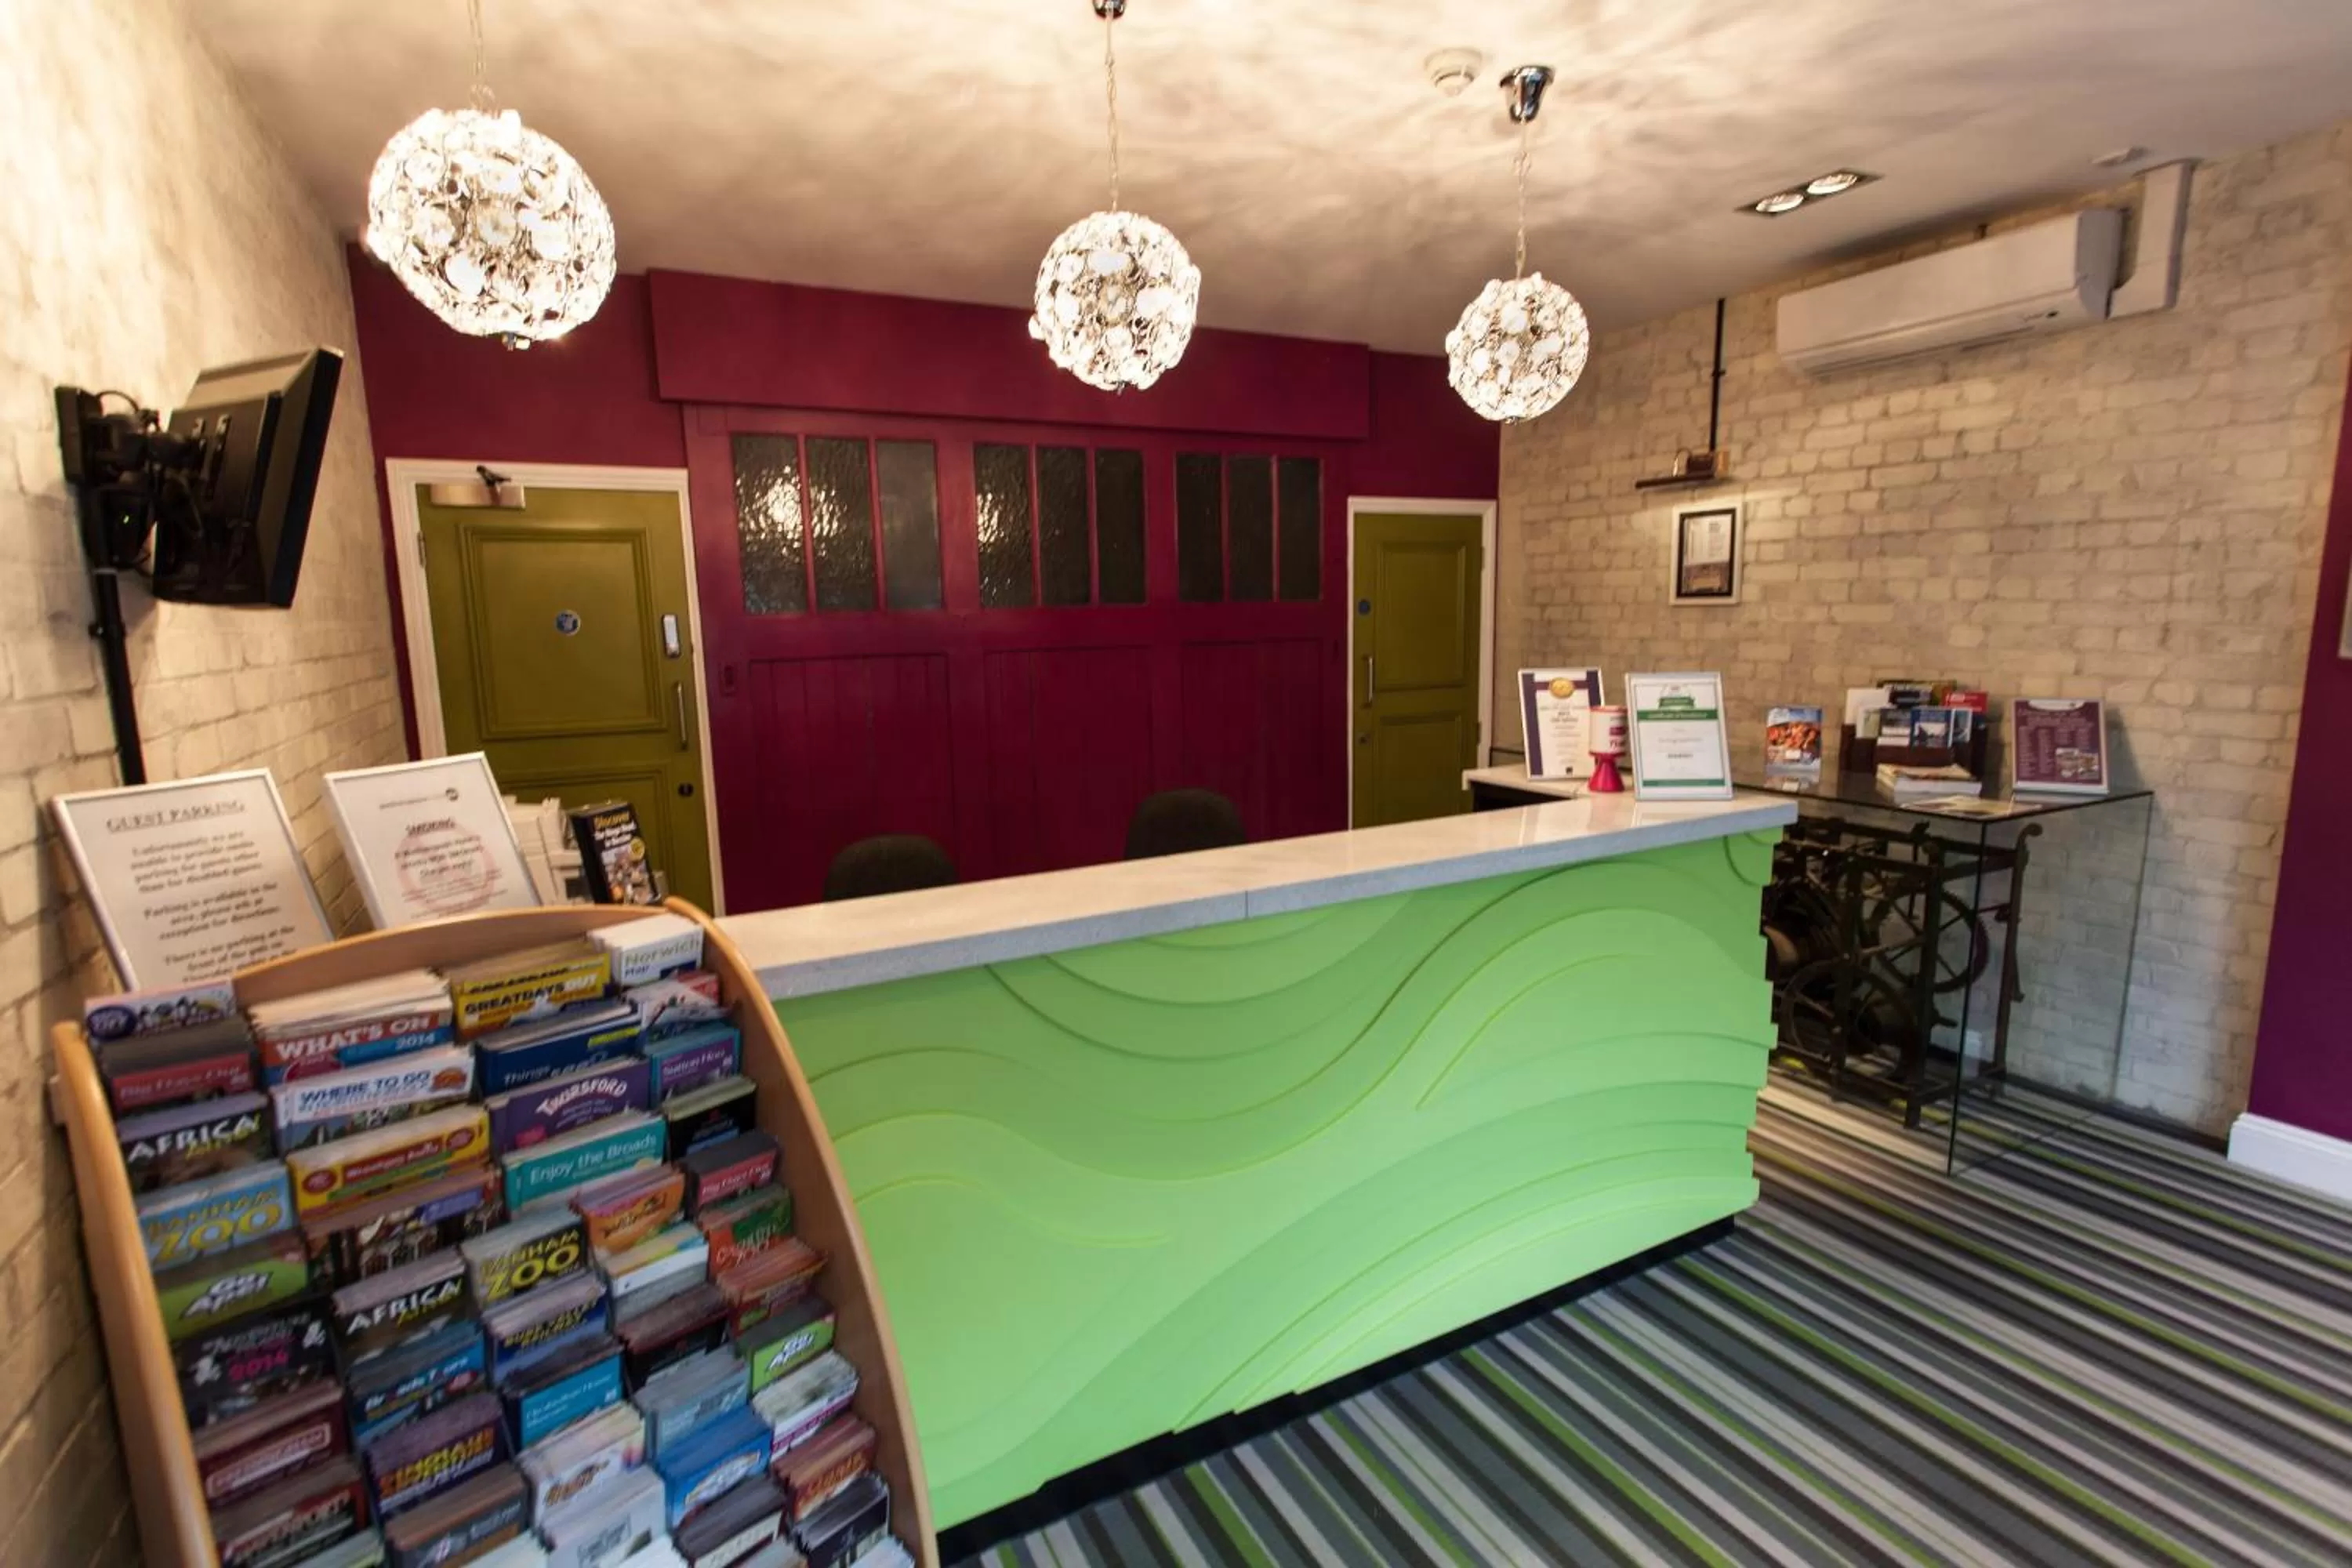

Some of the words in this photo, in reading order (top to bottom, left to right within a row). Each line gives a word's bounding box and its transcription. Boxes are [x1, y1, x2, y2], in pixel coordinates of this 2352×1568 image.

[106, 810, 164, 833] GUEST
[276, 1024, 383, 1061] WHAT'S
[389, 1016, 430, 1037] ON
[128, 1113, 257, 1164] AFRICA
[529, 1160, 574, 1188] Enjoy
[486, 1242, 582, 1302] ZOO
[346, 1279, 459, 1337] AFRICA
